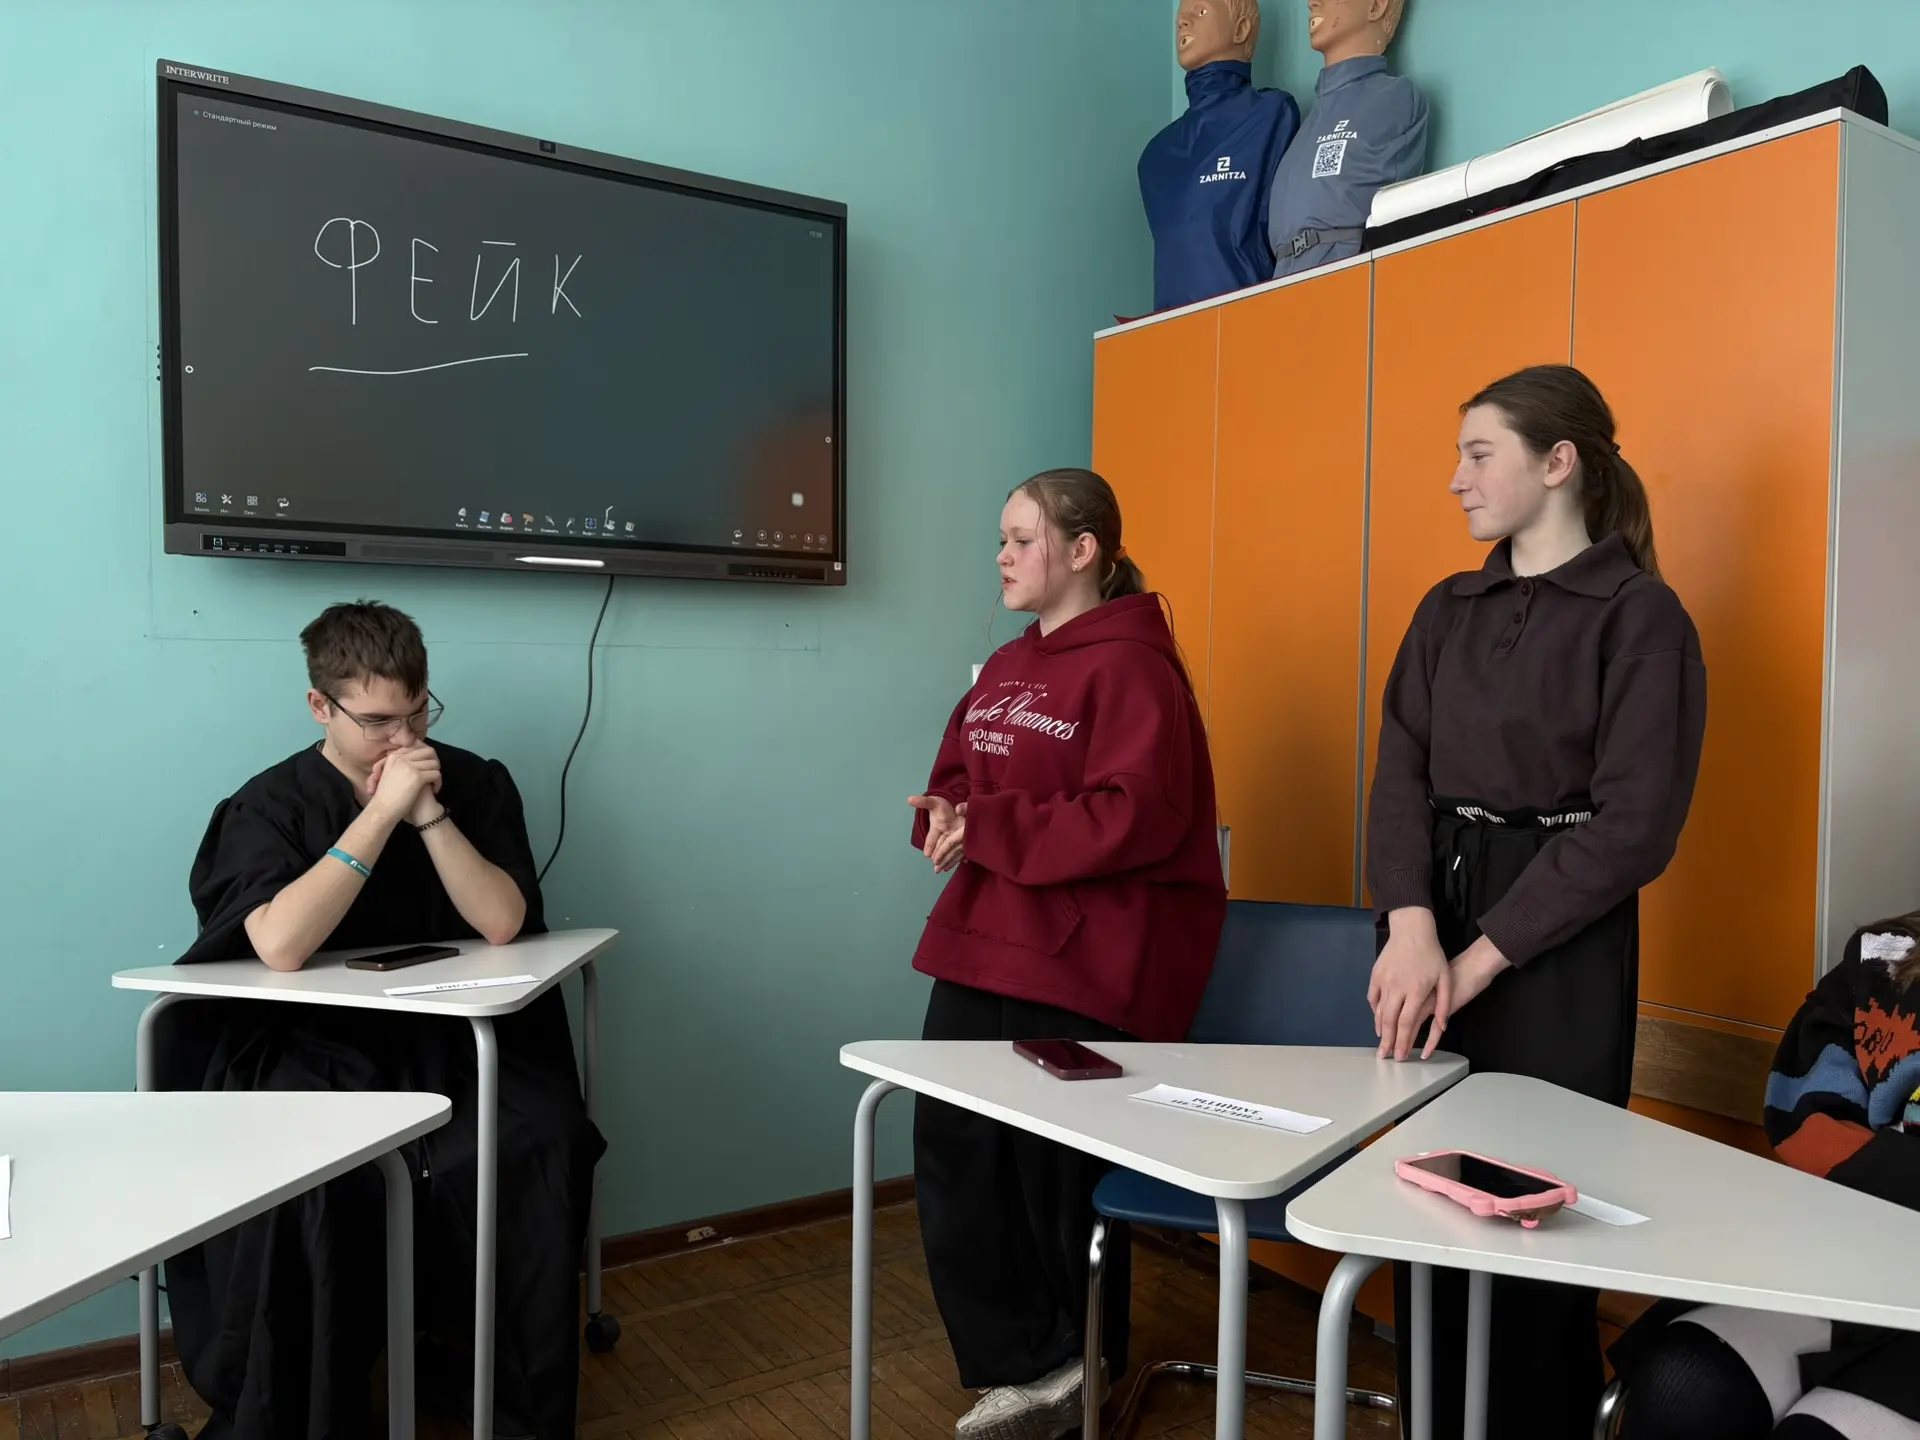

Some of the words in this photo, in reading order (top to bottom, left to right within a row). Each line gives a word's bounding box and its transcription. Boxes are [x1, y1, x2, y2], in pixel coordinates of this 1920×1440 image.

[165, 64, 230, 85] INTERWRITE
[202, 110, 252, 127] Стандартный
[252, 120, 277, 131] режим
[1316, 131, 1358, 144] ZARNITZA
[1199, 171, 1247, 184] ZARNITZA
[314, 217, 583, 326] ФЕЙК
[1003, 690, 1080, 741] Vacances
[1003, 733, 1015, 746] LES
